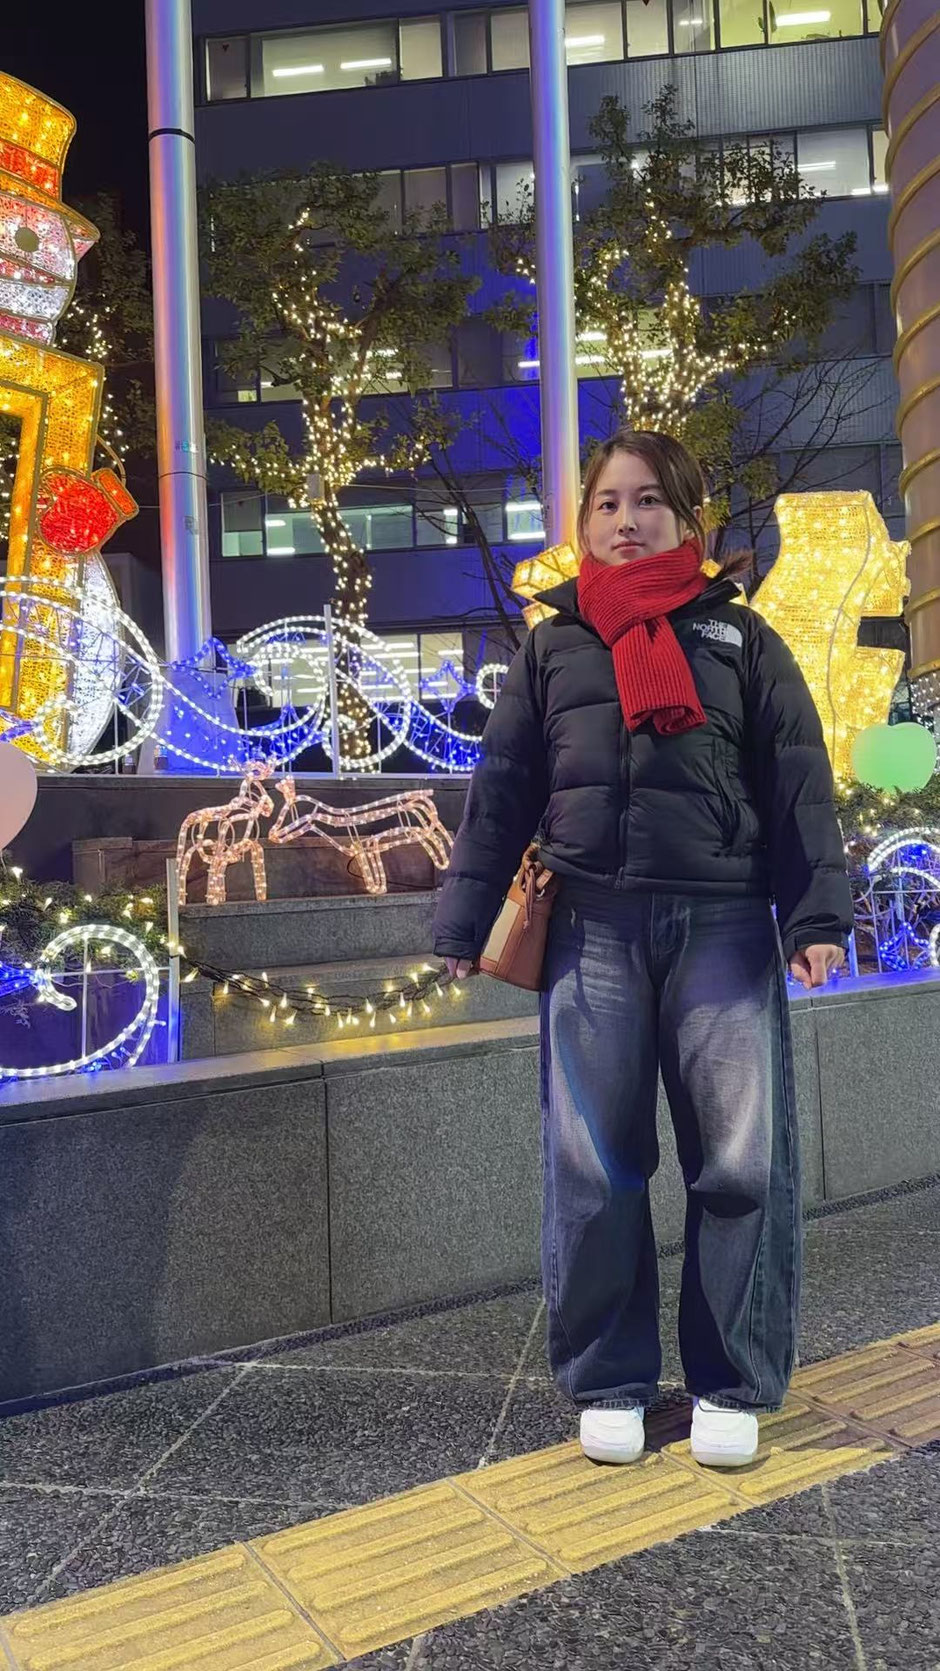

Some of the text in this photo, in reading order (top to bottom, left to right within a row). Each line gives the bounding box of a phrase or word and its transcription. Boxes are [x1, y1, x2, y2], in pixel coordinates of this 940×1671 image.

[693, 622, 727, 636] NORTH
[708, 618, 726, 629] THE
[701, 630, 726, 642] FACE
